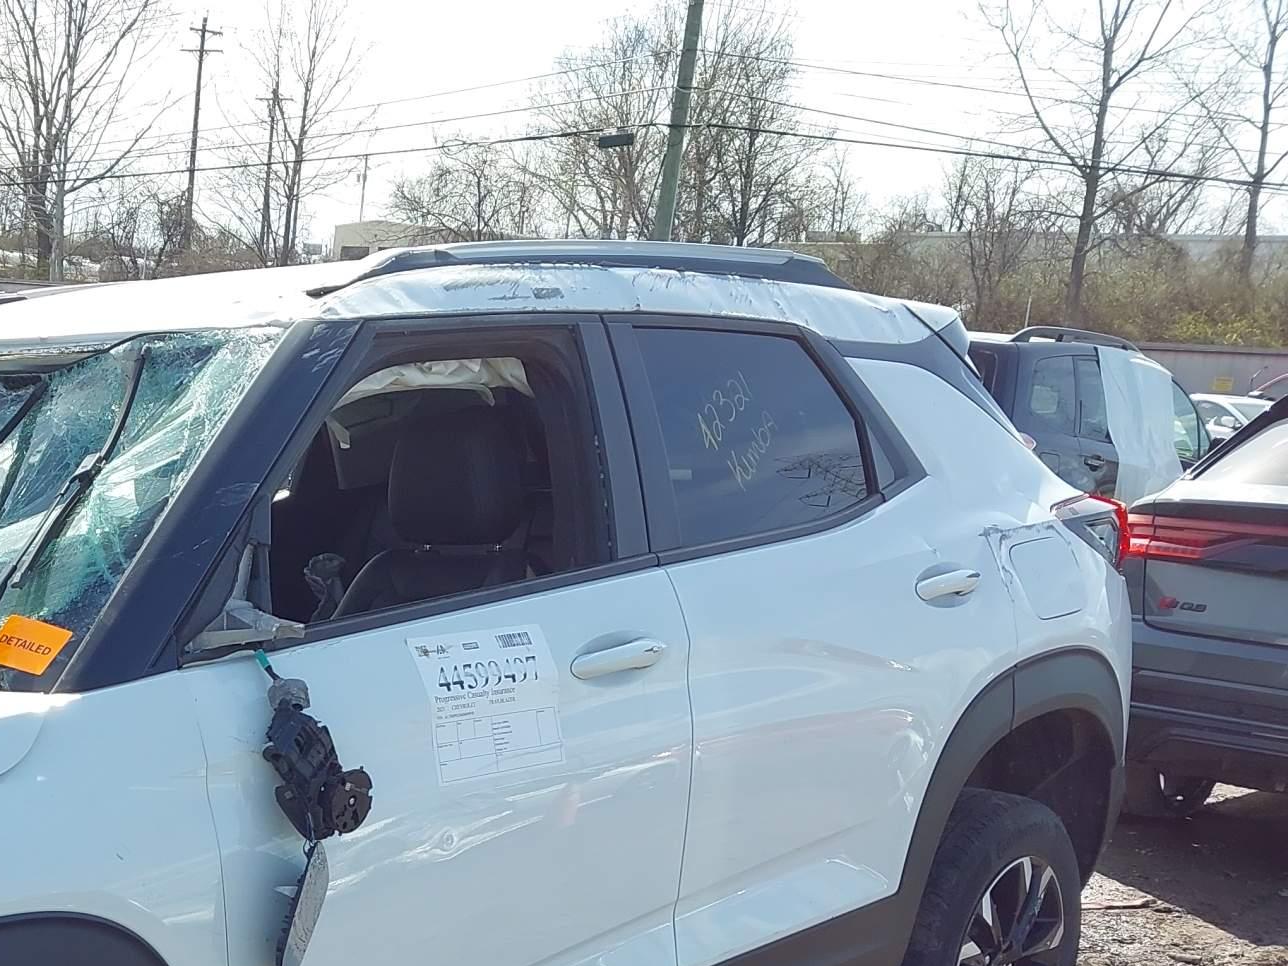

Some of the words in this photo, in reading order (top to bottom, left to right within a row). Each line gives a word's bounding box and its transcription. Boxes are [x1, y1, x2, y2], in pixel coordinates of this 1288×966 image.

[0, 634, 52, 656] DETAILED
[438, 655, 539, 692] 44599497
[490, 686, 516, 696] Insurance
